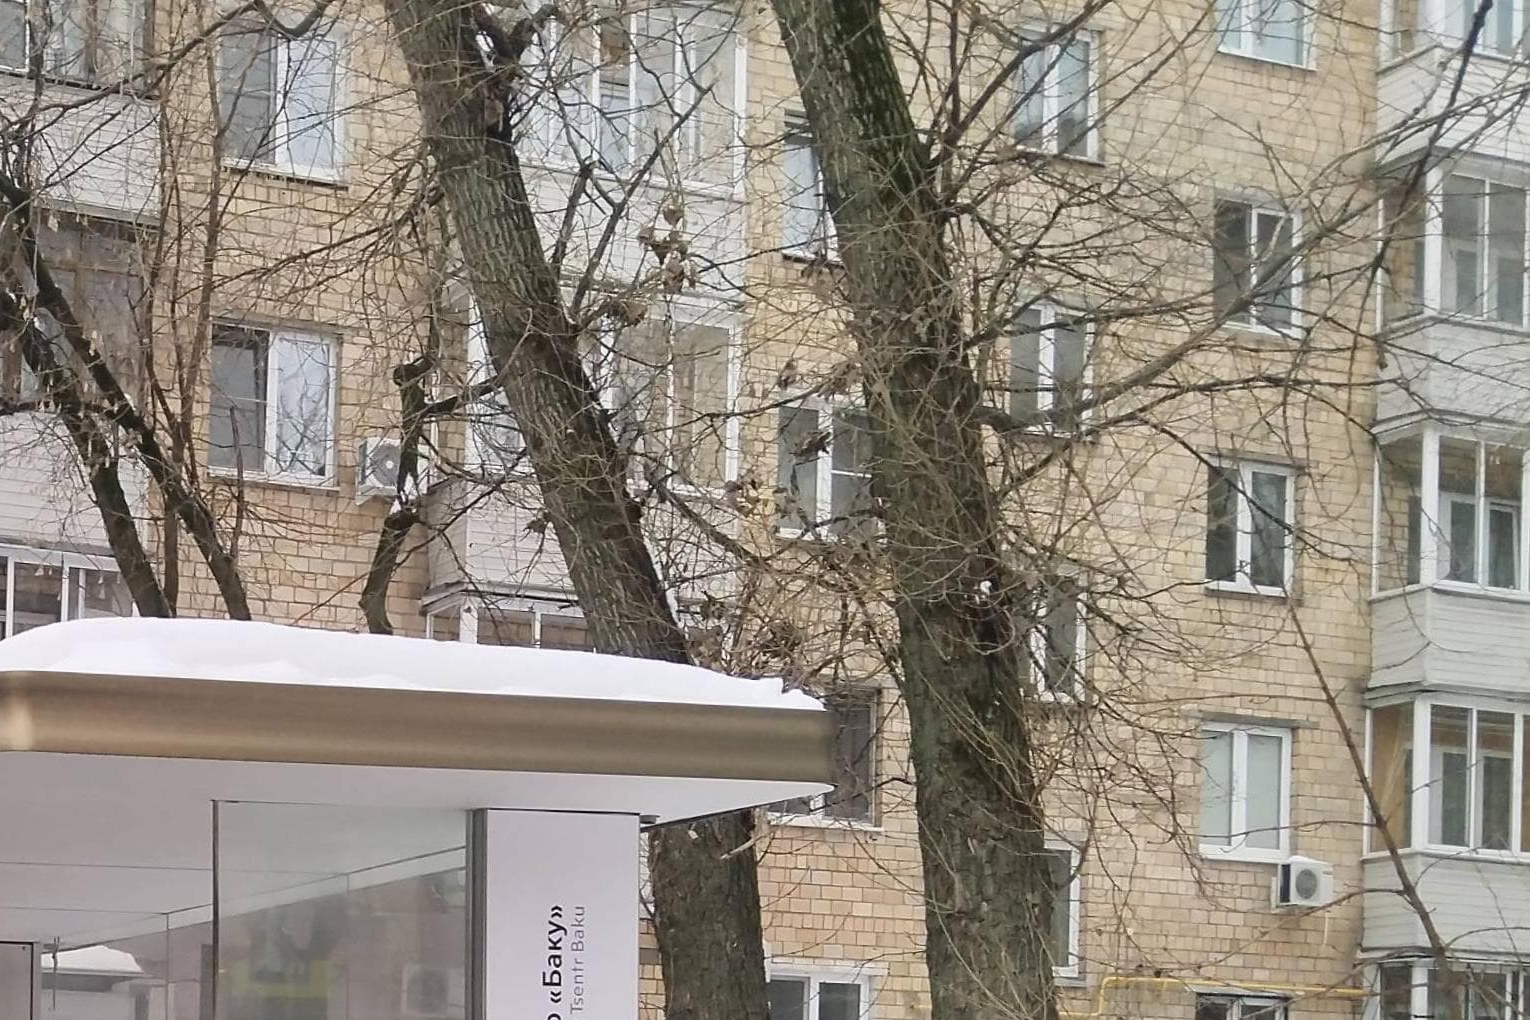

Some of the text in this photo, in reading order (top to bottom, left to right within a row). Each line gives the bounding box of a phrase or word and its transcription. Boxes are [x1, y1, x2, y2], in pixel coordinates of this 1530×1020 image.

[542, 905, 568, 1004] «Баку»
[570, 905, 586, 952] Baku
[570, 957, 585, 1015] Tsentr
